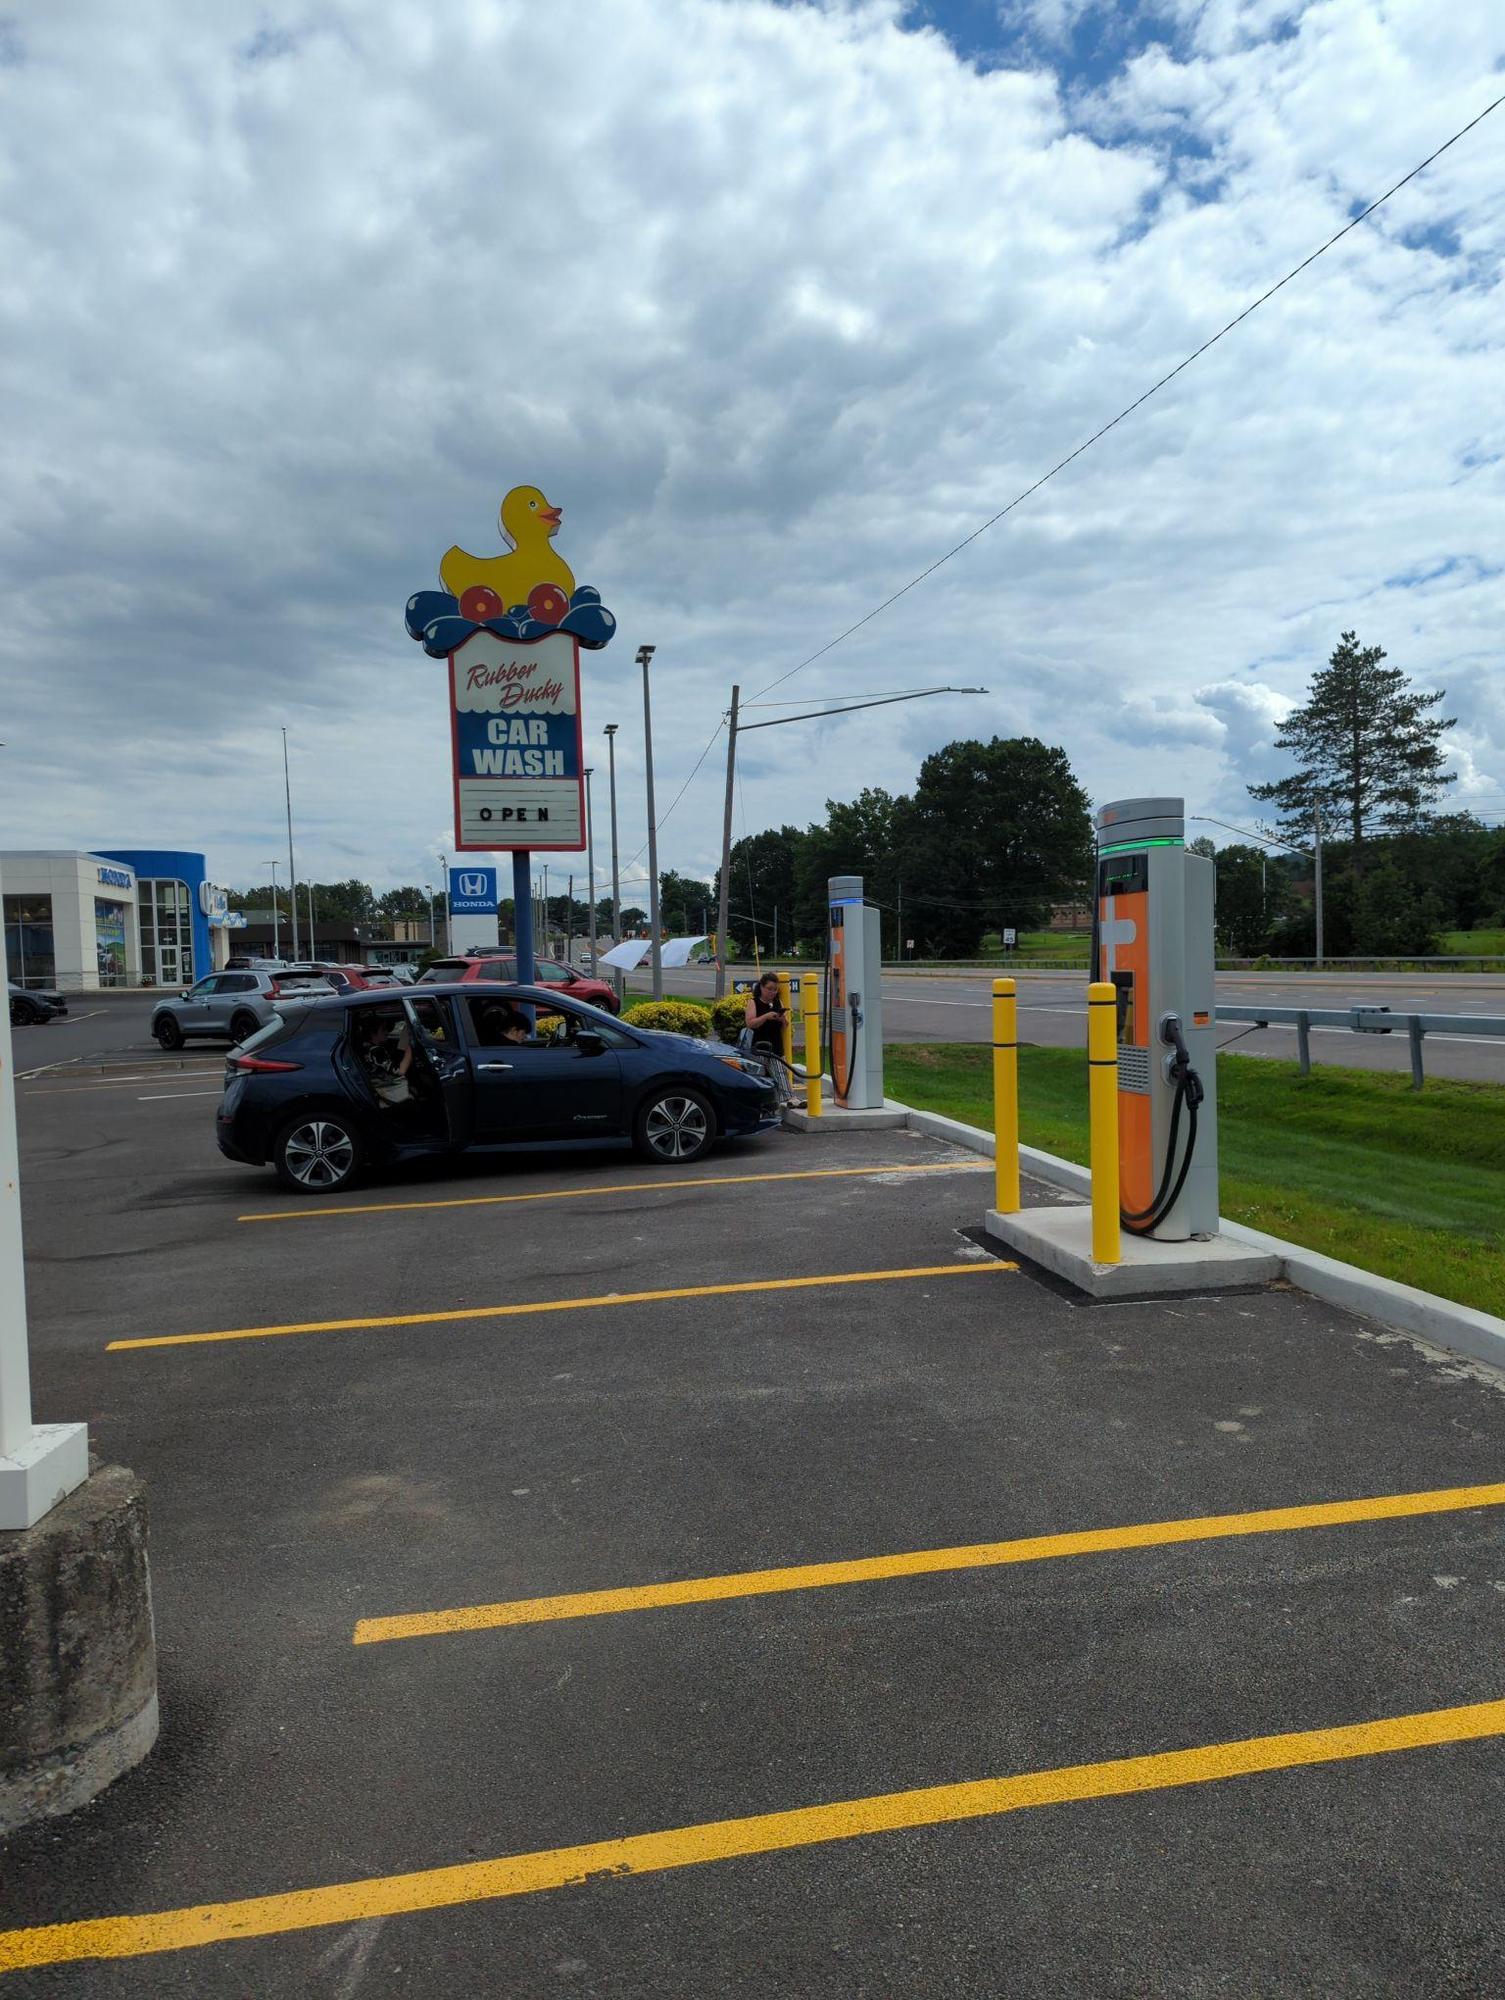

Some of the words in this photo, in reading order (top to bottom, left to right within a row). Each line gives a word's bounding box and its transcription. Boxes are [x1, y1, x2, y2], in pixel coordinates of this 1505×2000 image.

[466, 661, 538, 691] Rubber
[499, 678, 564, 709] Ducky
[487, 718, 549, 745] CAR
[472, 748, 564, 775] WASH
[479, 807, 549, 822] OPEN
